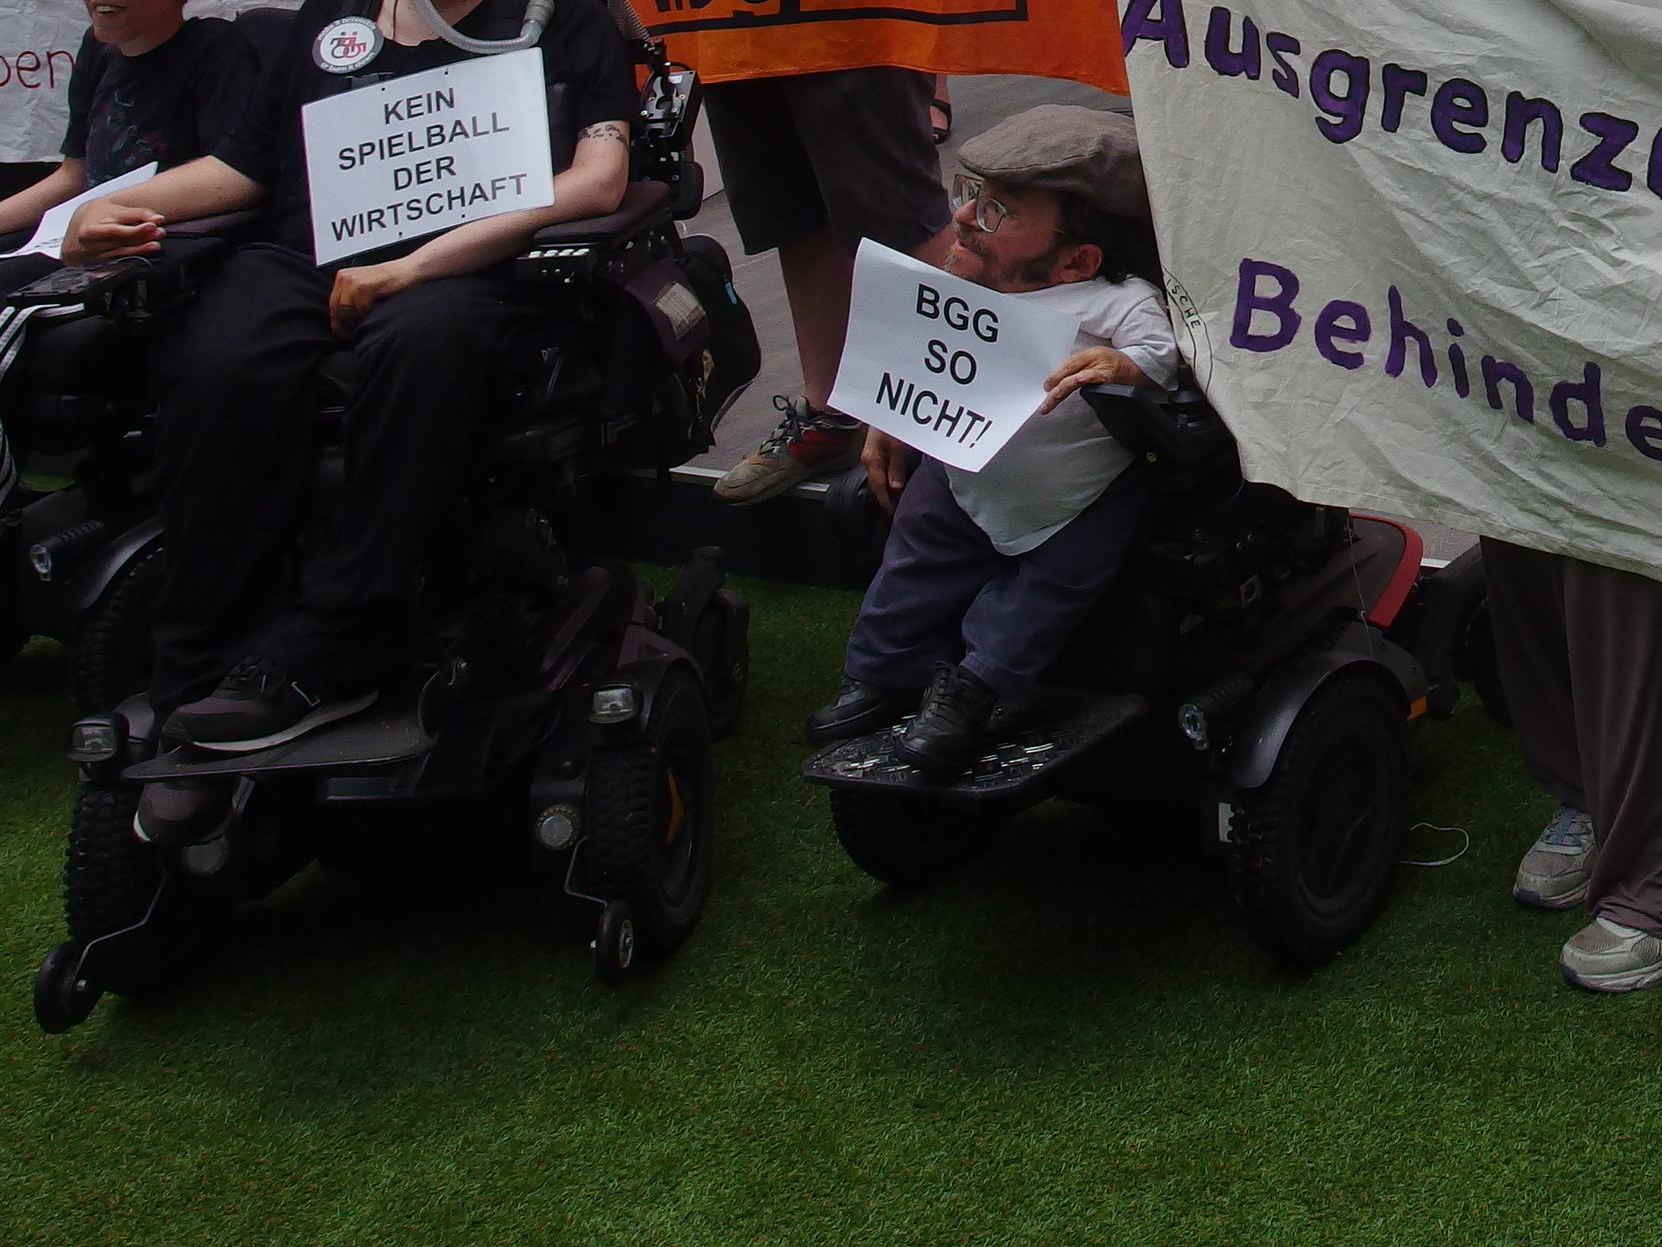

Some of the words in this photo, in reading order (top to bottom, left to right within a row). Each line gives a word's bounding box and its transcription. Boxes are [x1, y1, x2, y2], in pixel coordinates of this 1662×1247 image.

[383, 87, 456, 125] KEIN
[338, 112, 510, 170] SPIELBALL
[393, 156, 456, 191] DER
[331, 173, 527, 242] WIRTSCHAFT
[915, 283, 999, 343] BGG
[924, 339, 977, 385] SO
[876, 372, 993, 448] NICHT!
